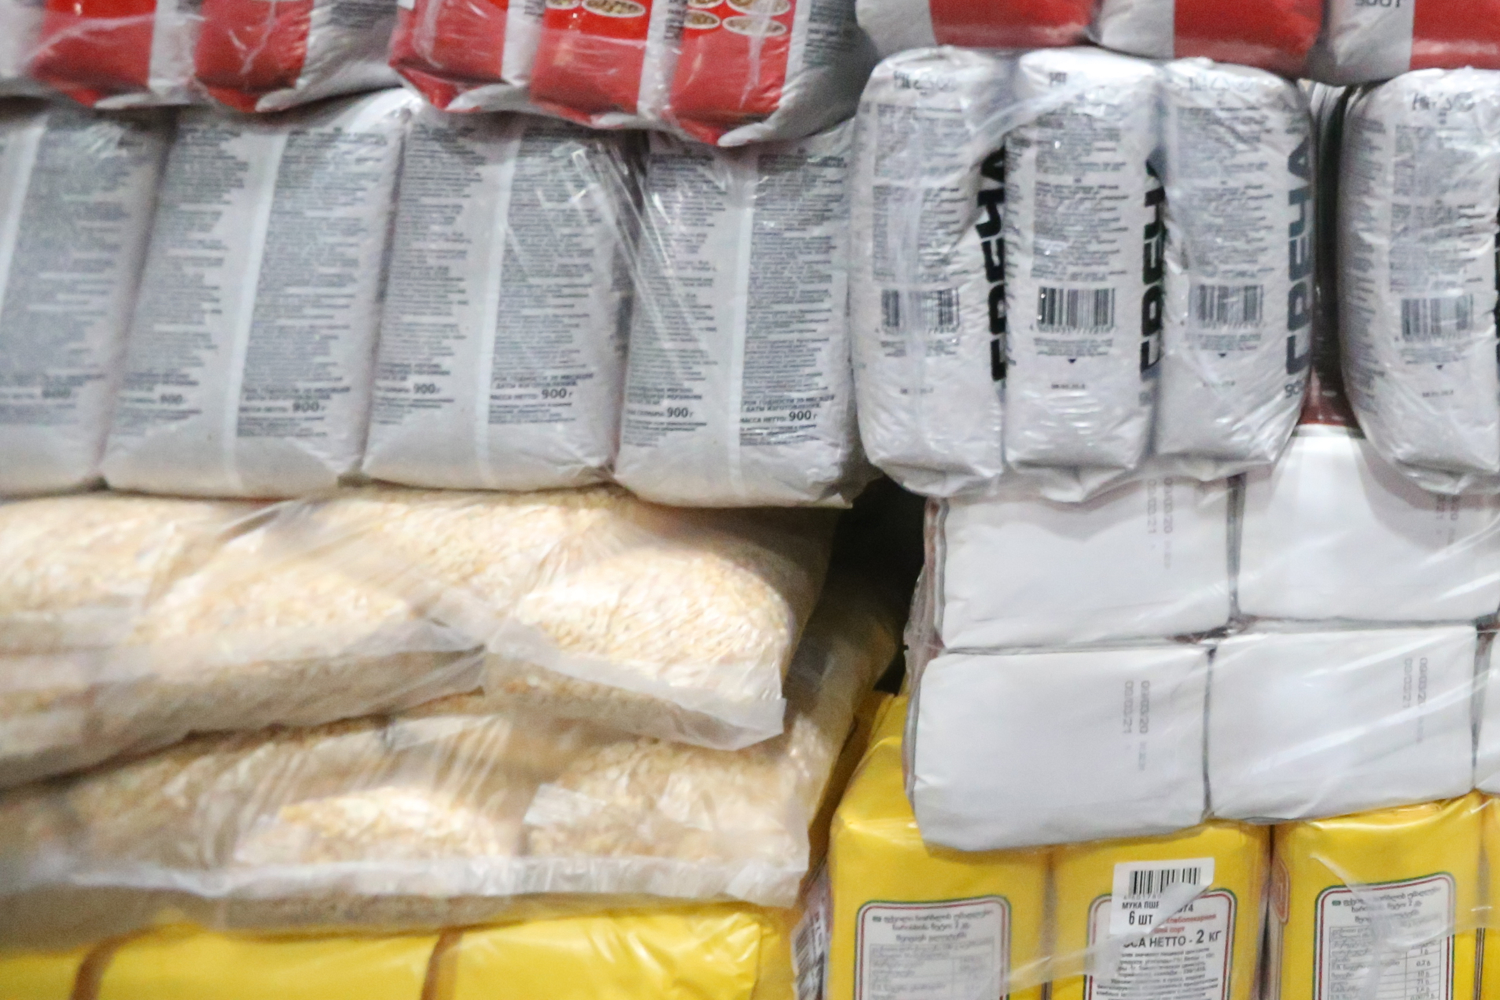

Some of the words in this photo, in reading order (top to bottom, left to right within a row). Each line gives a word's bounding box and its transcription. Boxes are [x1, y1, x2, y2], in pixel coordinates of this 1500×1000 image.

[541, 388, 567, 399] 900
[667, 407, 689, 418] 900
[789, 410, 811, 421] 900
[1129, 911, 1135, 925] 6
[1149, 936, 1186, 947] НЕТТО
[1196, 929, 1205, 944] 2
